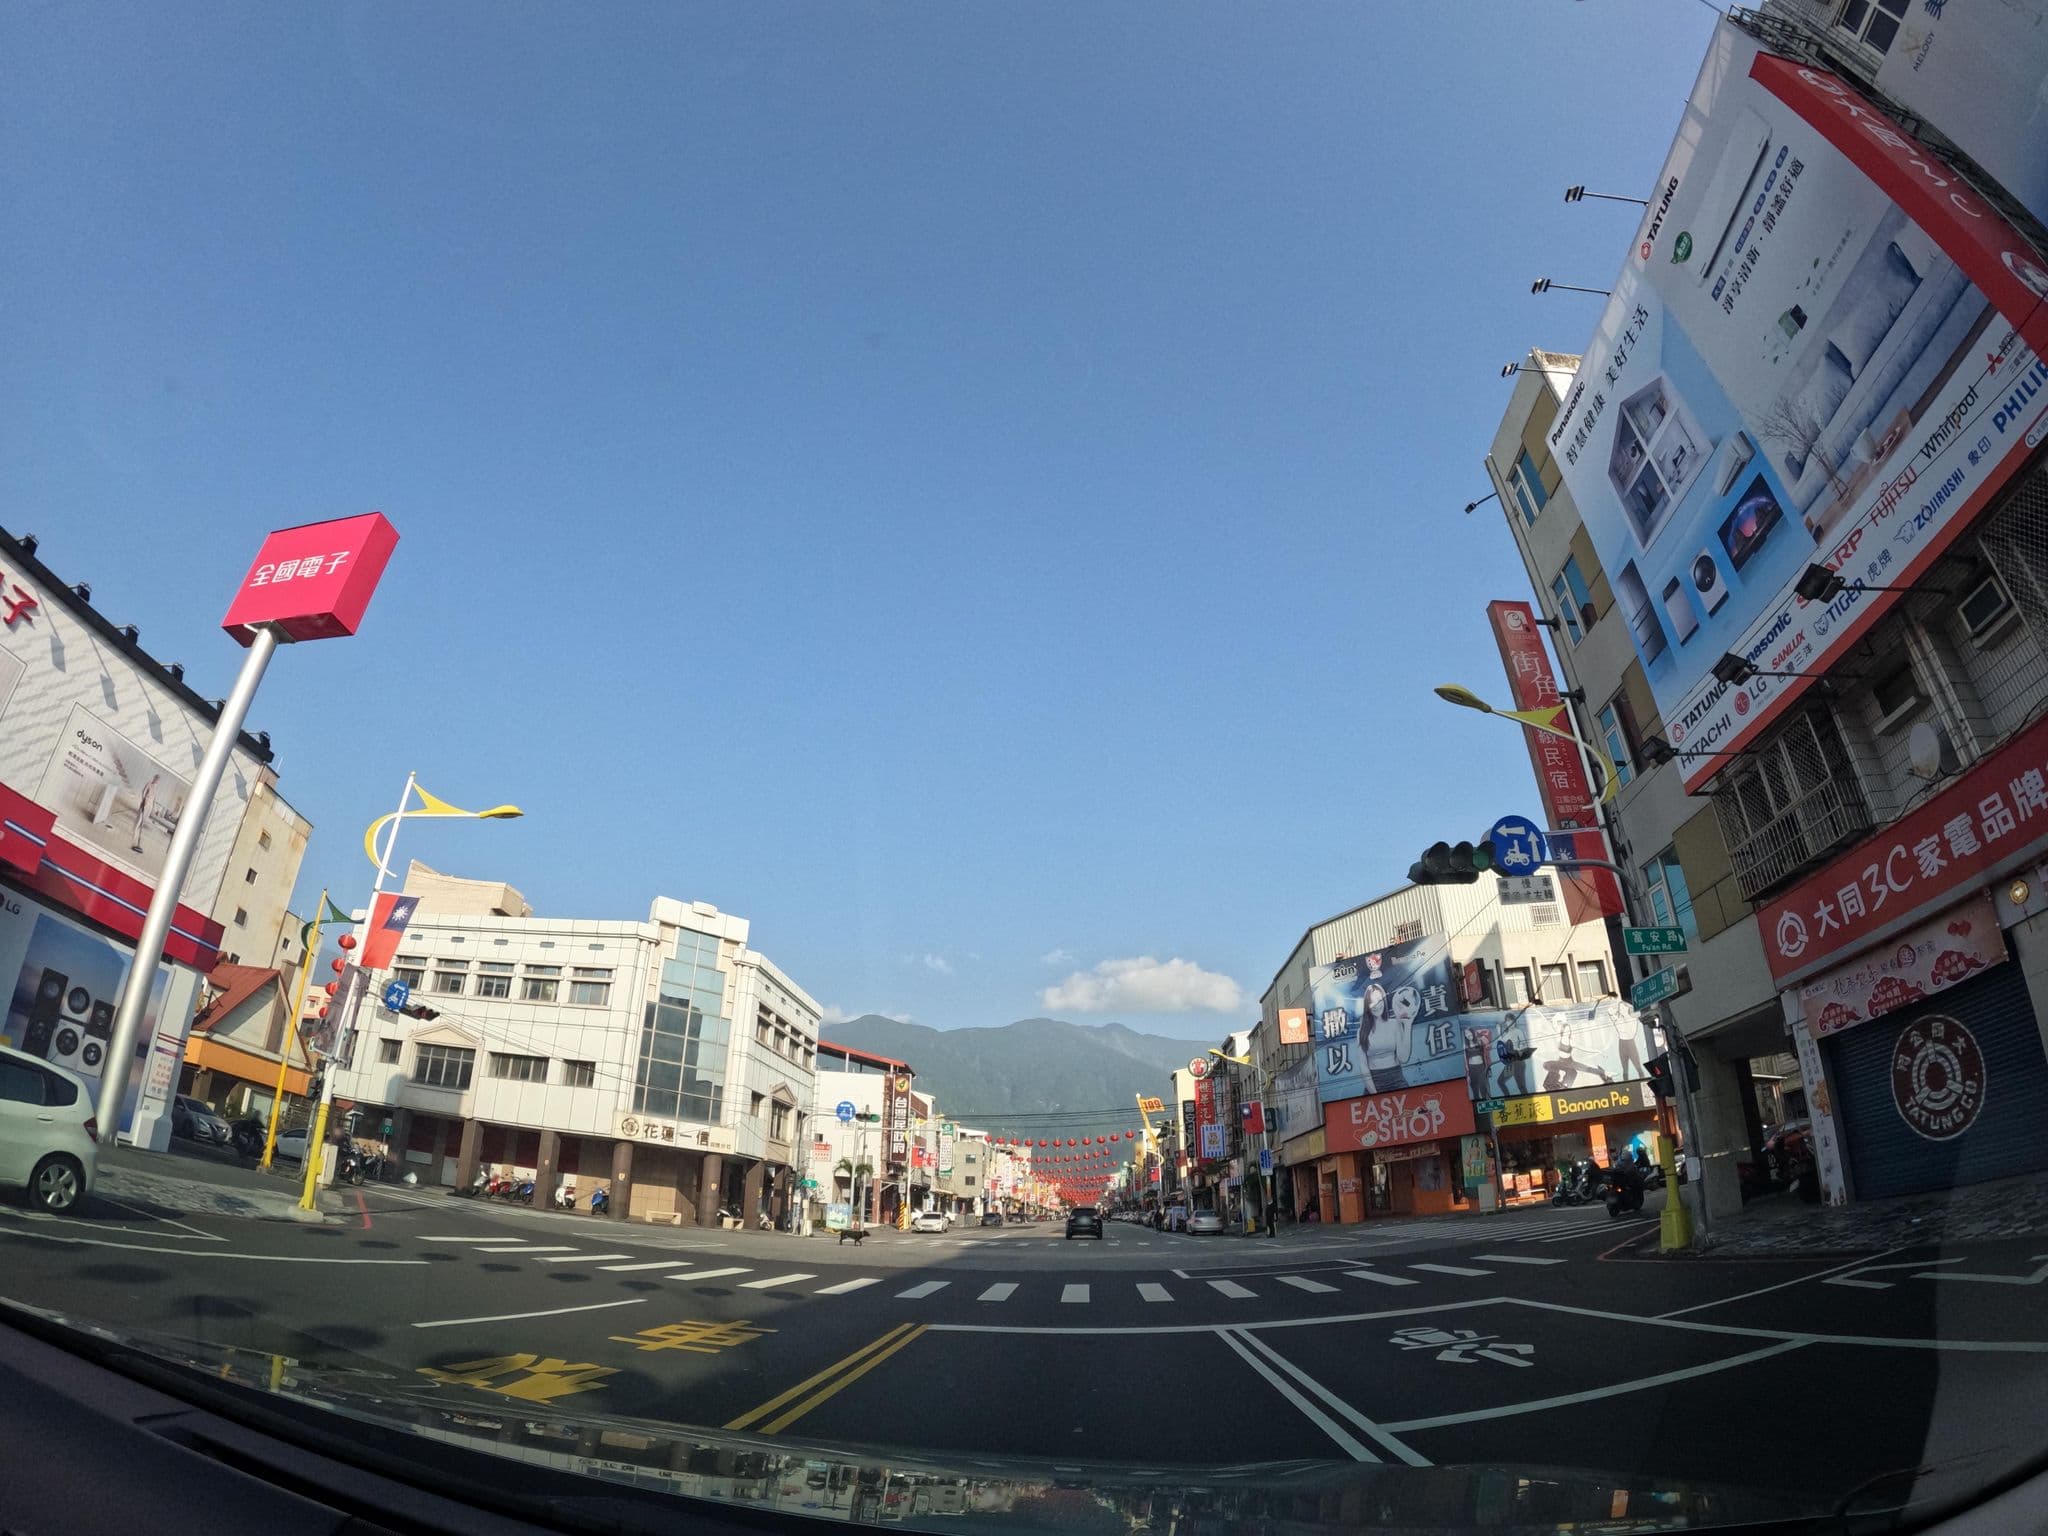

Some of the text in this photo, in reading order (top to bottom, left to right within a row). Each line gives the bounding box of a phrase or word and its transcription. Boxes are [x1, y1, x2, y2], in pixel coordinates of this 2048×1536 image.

[1913, 32, 1935, 72] MELODY
[1647, 176, 1679, 242] TATUNG
[1566, 304, 1648, 466] 智慧健康 美好生活
[1551, 381, 1585, 447] Panasonic
[1921, 385, 1979, 460] Whirlpool
[1967, 436, 1992, 467] 象印
[1870, 465, 1917, 527] FUJITSU
[1913, 467, 1966, 532] ZOJIRUSHI
[249, 551, 350, 587] 全國電子
[1867, 549, 1893, 581] 虎牌
[1826, 576, 1866, 624] TIGER
[1745, 612, 1792, 666] nasonic
[1772, 629, 1805, 671] SANLUX
[1682, 681, 1729, 729] TATUNG
[1749, 676, 1767, 700] LG
[1510, 649, 1571, 790] 街角緻民宿
[77, 730, 103, 752] dyson
[1681, 714, 1732, 769] HITACHI
[5, 901, 21, 915] LG
[1632, 929, 1678, 943] 富安路
[1636, 970, 1671, 997] 中山路
[1351, 1093, 1408, 1125] EASY
[1558, 1096, 1609, 1115] Banana
[1610, 1091, 1630, 1107] Pie
[1904, 1096, 1965, 1131] TATUNG
[644, 1123, 709, 1147] 花蓮一信
[1378, 1108, 1446, 1143] SHOP
